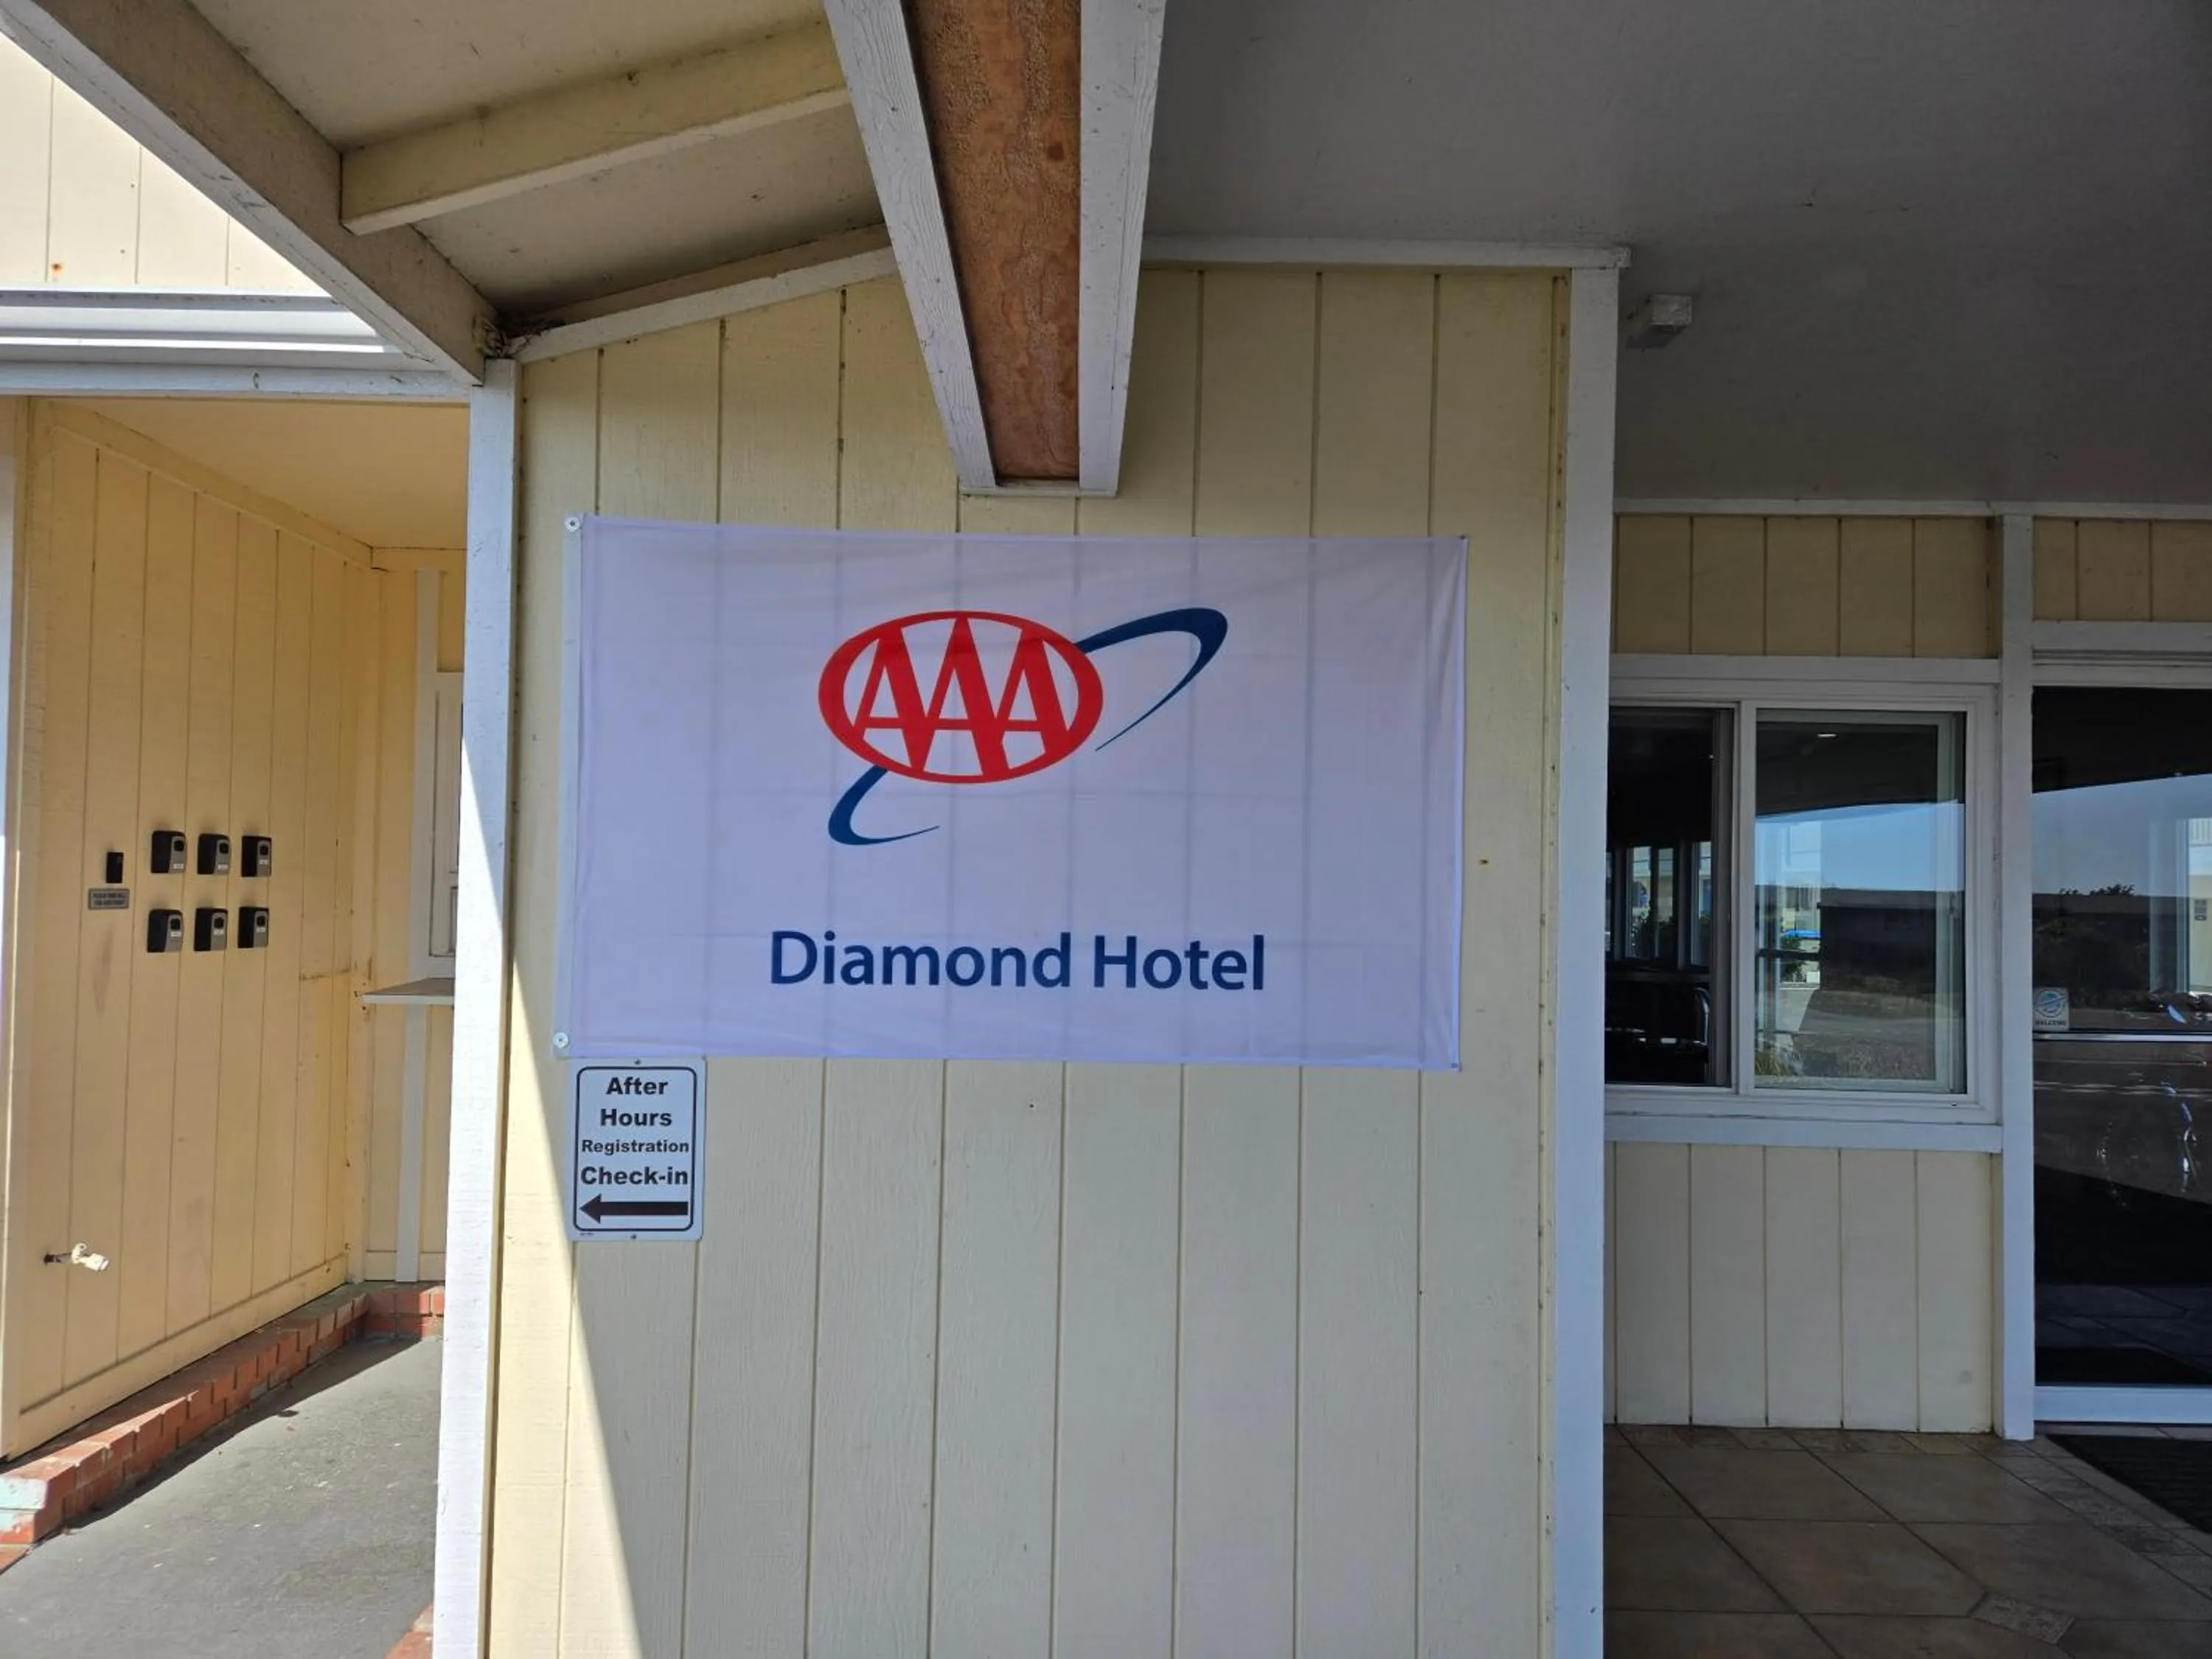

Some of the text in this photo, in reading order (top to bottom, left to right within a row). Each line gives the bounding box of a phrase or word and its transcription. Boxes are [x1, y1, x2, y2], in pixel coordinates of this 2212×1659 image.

[841, 613, 1081, 780] AAA
[771, 930, 1265, 990] Diamond Hotel
[605, 1077, 668, 1095] After
[600, 1108, 672, 1127] Hours
[581, 1139, 689, 1155] Registration
[580, 1166, 688, 1185] Check-in
